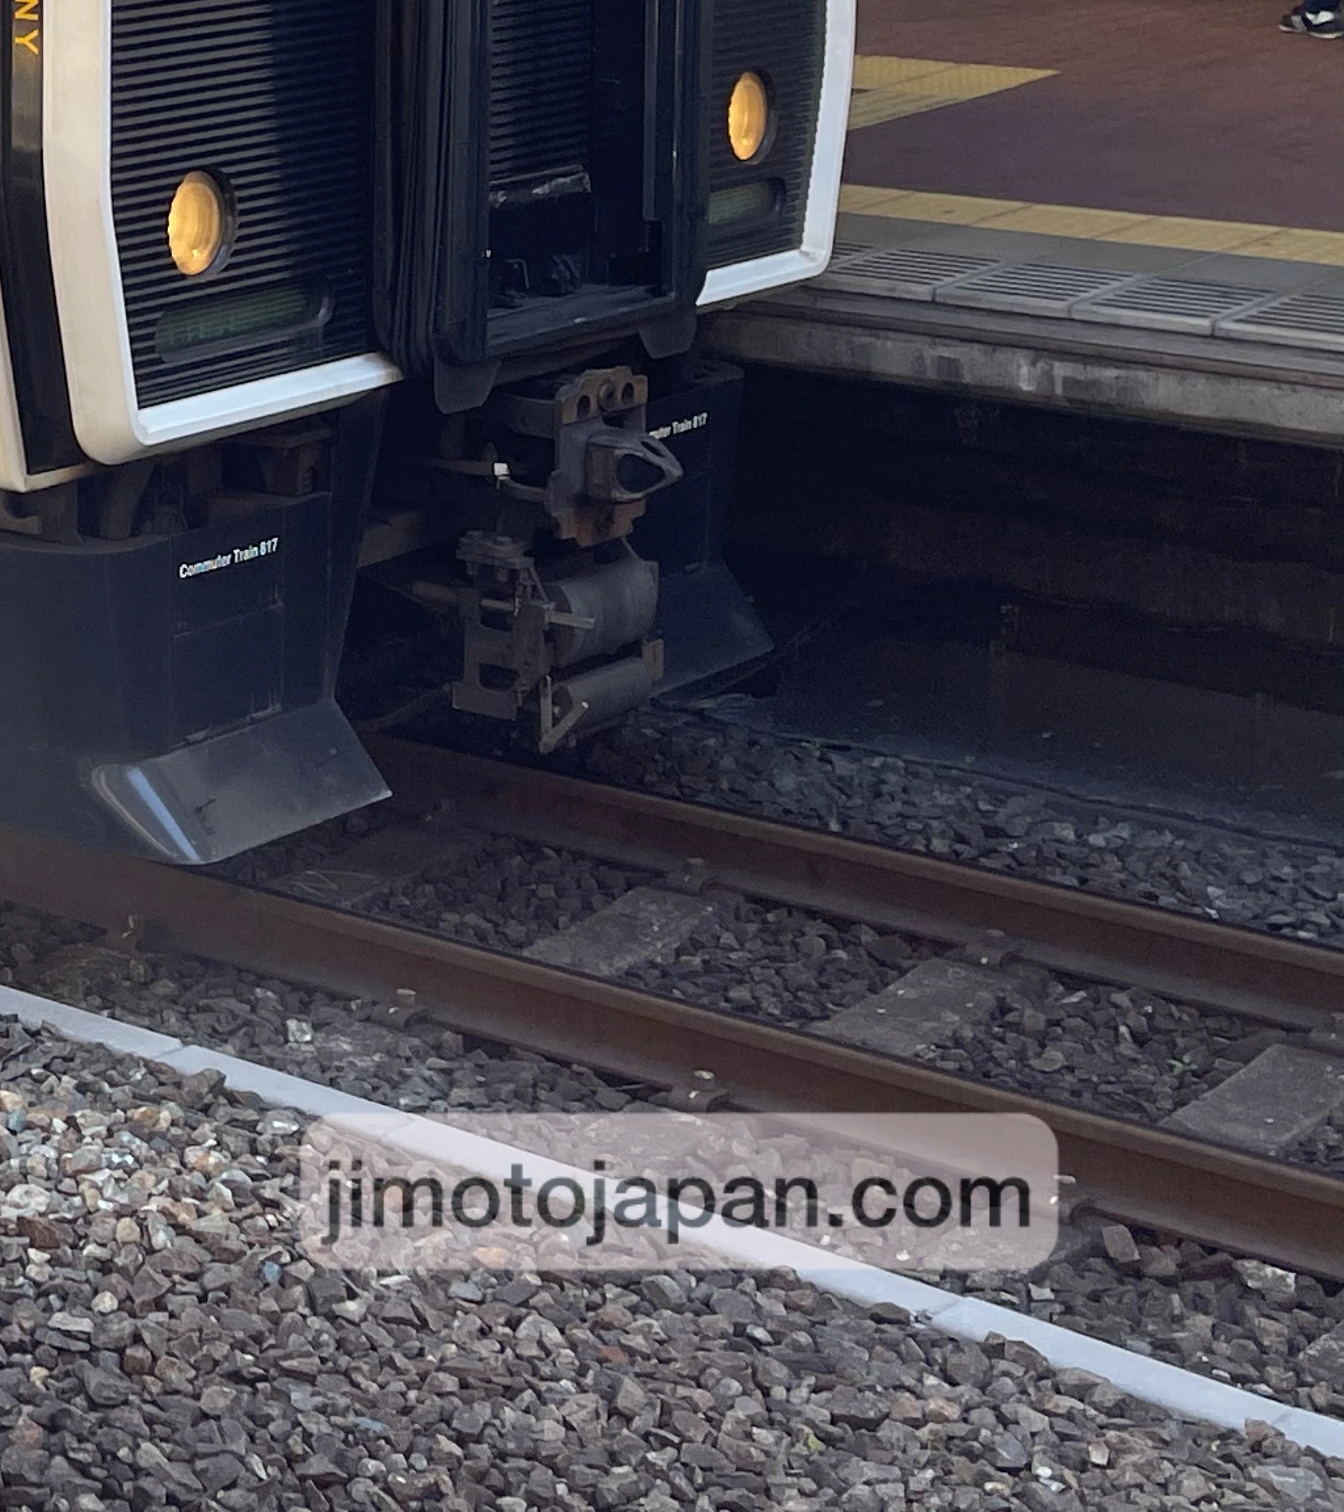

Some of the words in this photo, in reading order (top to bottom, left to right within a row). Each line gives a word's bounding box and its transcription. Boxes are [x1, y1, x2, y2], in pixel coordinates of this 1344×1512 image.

[179, 553, 232, 579] Commuter
[233, 545, 259, 564] Train
[259, 537, 279, 556] 817
